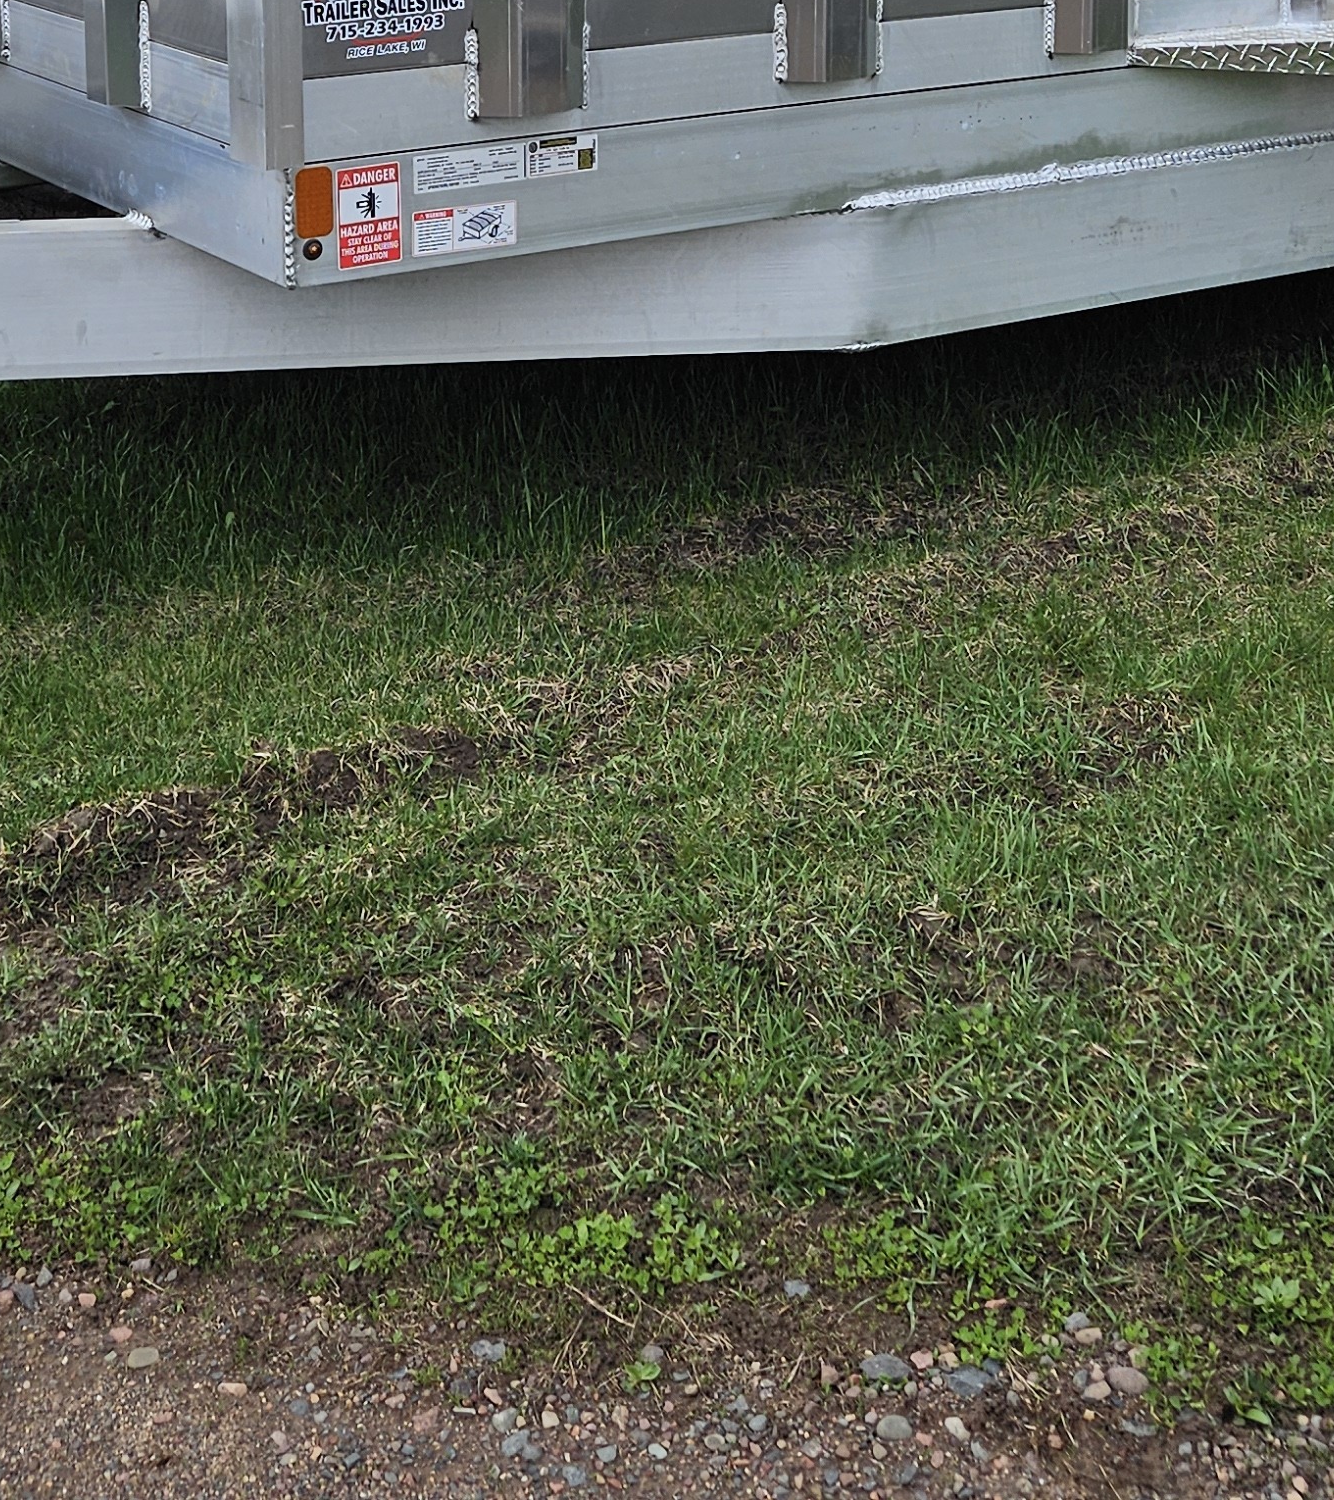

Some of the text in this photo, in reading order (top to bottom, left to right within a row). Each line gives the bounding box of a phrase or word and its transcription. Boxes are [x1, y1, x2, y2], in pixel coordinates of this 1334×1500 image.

[303, 0, 370, 25] TRAILER
[326, 15, 444, 41] 715-234-1993
[347, 40, 426, 58] RICE LAKE, WI
[353, 167, 396, 185] DANGER
[340, 219, 398, 238] HAZARD AREA
[341, 240, 399, 257] THIS AREA DURING
[347, 232, 393, 247] STAY CLEAR OF
[352, 251, 389, 264] OPERATION
